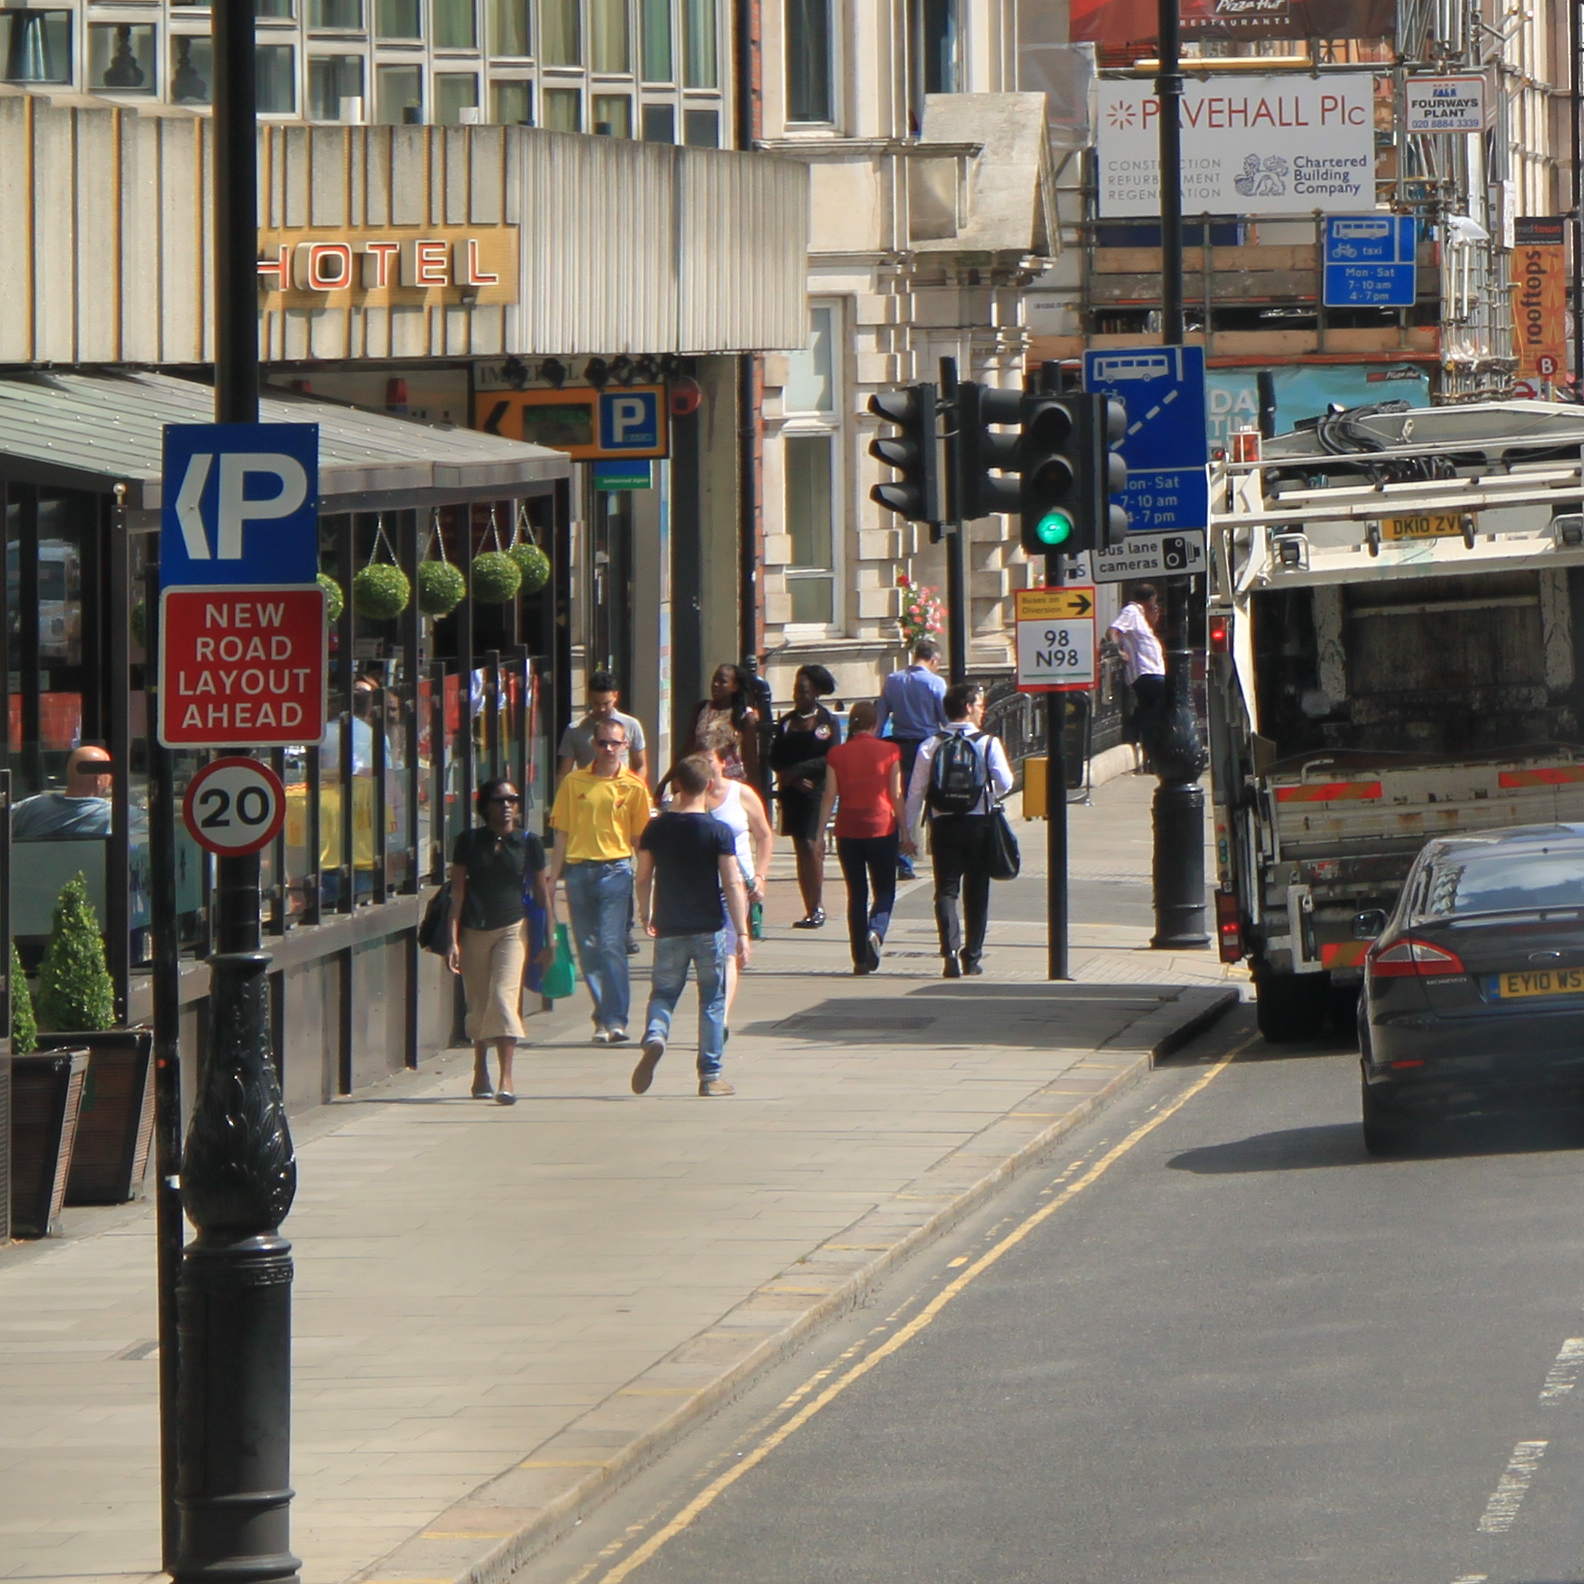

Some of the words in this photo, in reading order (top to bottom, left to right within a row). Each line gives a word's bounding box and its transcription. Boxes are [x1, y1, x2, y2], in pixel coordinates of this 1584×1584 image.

[1180, 17, 1290, 27] RESTAURANTS
[1411, 99, 1478, 109] FOURWAYS
[1142, 96, 1309, 130] PVEHALL
[1321, 95, 1366, 126] Plc
[1424, 109, 1466, 118] PLANT
[1411, 120, 1429, 129] 020
[1108, 158, 1221, 172] CONSTCTION
[1294, 155, 1367, 168] Chartered
[1108, 173, 1220, 186] REFURBMENT
[1294, 168, 1350, 183] Building
[1294, 182, 1361, 197] Company
[1363, 247, 1382, 255] taxi
[257, 239, 499, 292] HOTEL
[1346, 268, 1368, 277] Mon
[1377, 267, 1395, 277] Sat
[1373, 292, 1389, 301] pm
[1520, 250, 1547, 345] rooftops
[612, 398, 646, 443] P
[217, 453, 307, 560] P
[1157, 496, 1177, 506] am
[1154, 512, 1175, 525] pm
[1393, 517, 1430, 535] DK10
[1129, 539, 1158, 554] lane
[1099, 558, 1158, 574] cameras
[205, 601, 285, 628] NEW
[1022, 606, 1062, 614] Diversion
[1044, 630, 1070, 648] 98
[196, 636, 293, 662] ROAD
[1036, 649, 1079, 668] N98
[179, 668, 311, 696] LAYOUT
[181, 701, 303, 728] AHEAD
[199, 785, 270, 828] 20
[1507, 973, 1550, 993] EY10
